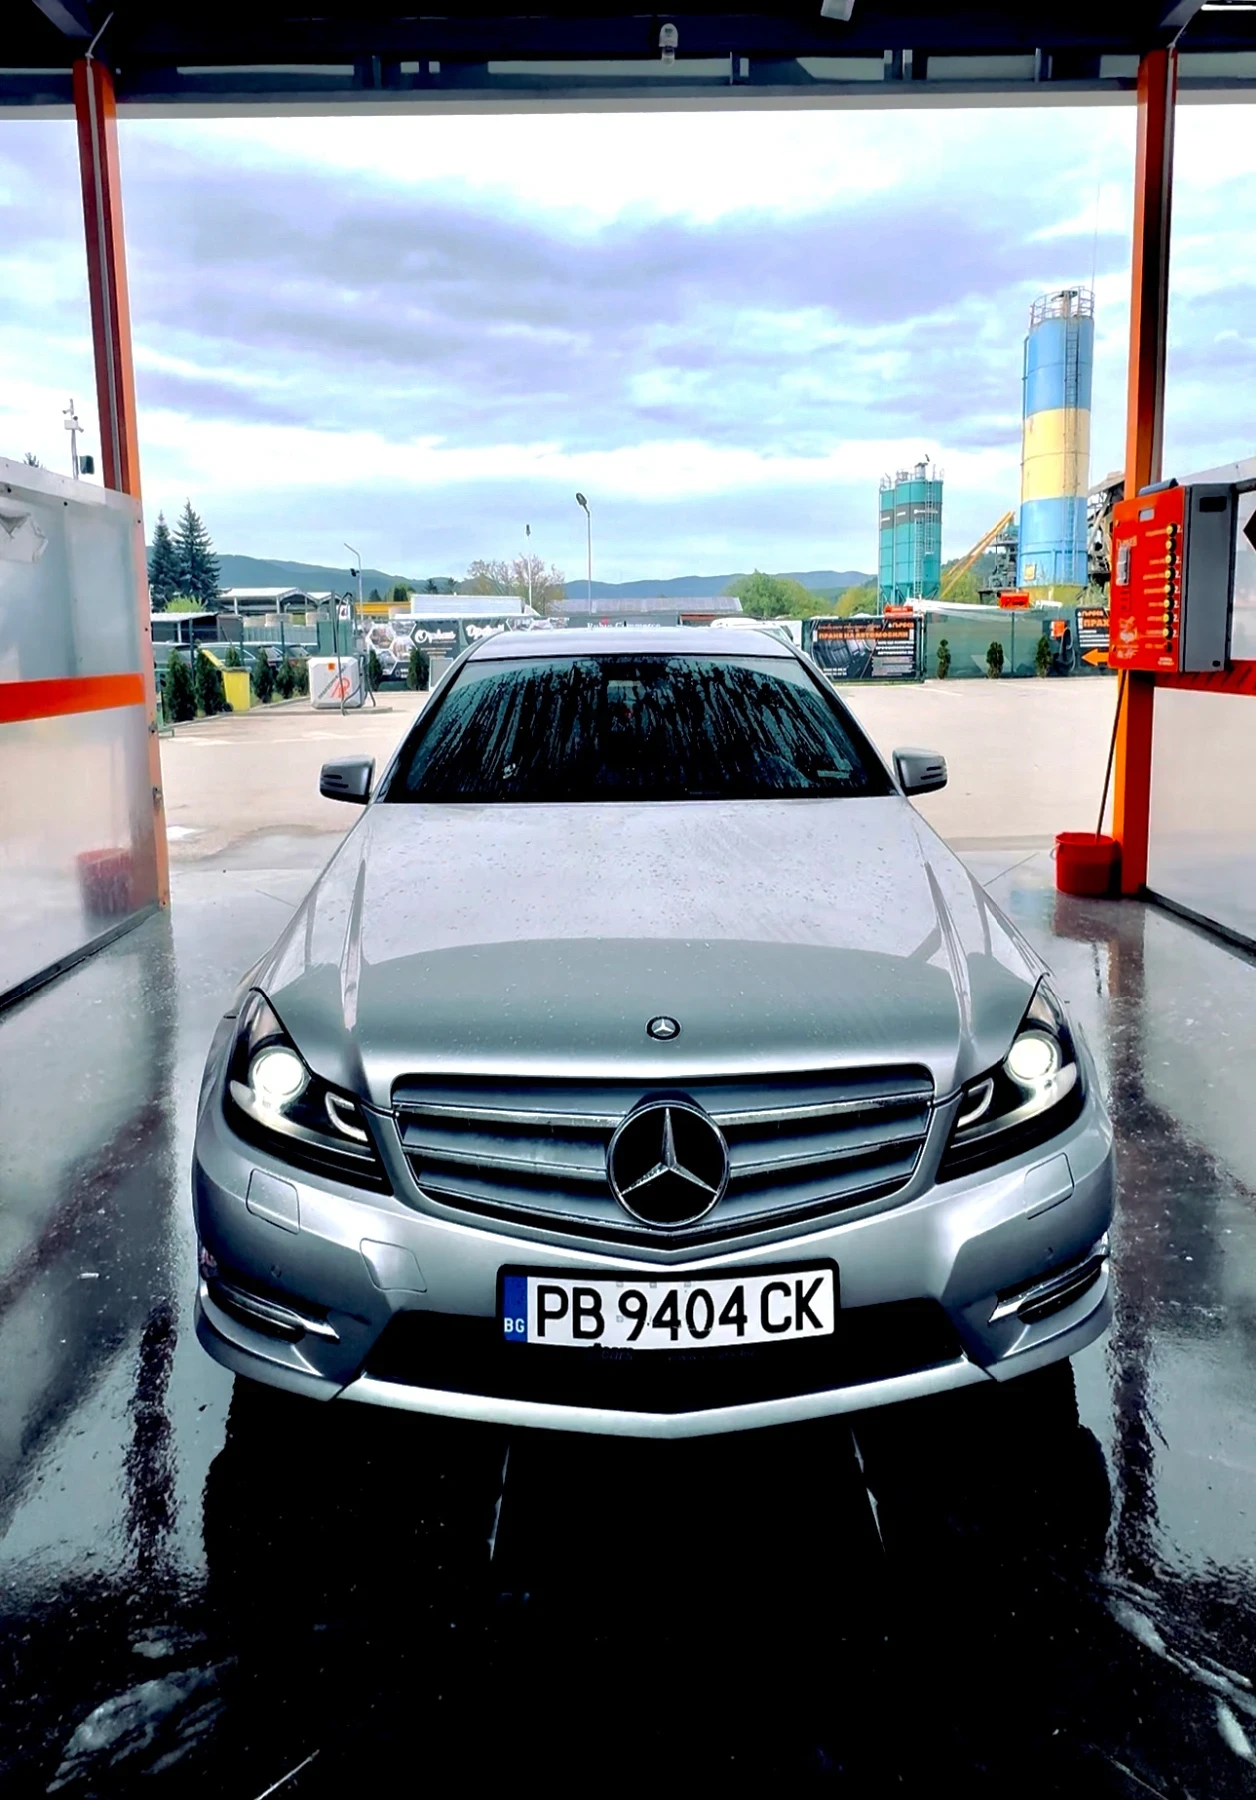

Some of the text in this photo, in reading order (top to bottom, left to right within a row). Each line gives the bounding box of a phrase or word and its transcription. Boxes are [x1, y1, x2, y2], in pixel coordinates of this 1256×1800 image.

[504, 1317, 525, 1334] BG
[537, 1277, 825, 1342] PB 9404 CK
